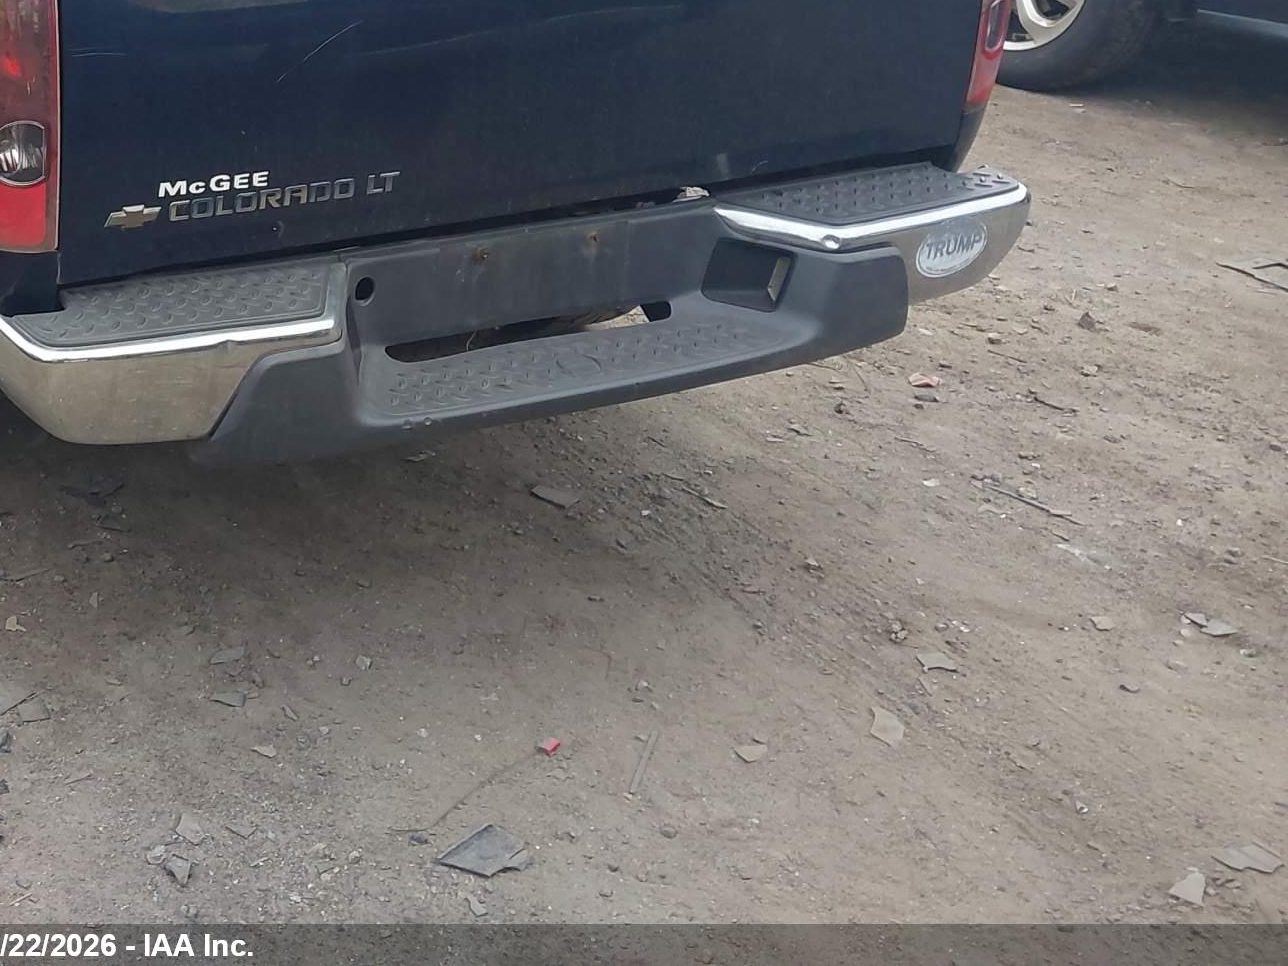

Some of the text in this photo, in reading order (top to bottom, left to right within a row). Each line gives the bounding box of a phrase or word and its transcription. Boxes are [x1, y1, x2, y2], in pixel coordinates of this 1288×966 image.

[158, 171, 270, 198] McGEE
[168, 170, 401, 222] COLORADO LT
[925, 233, 983, 260] TRUMP
